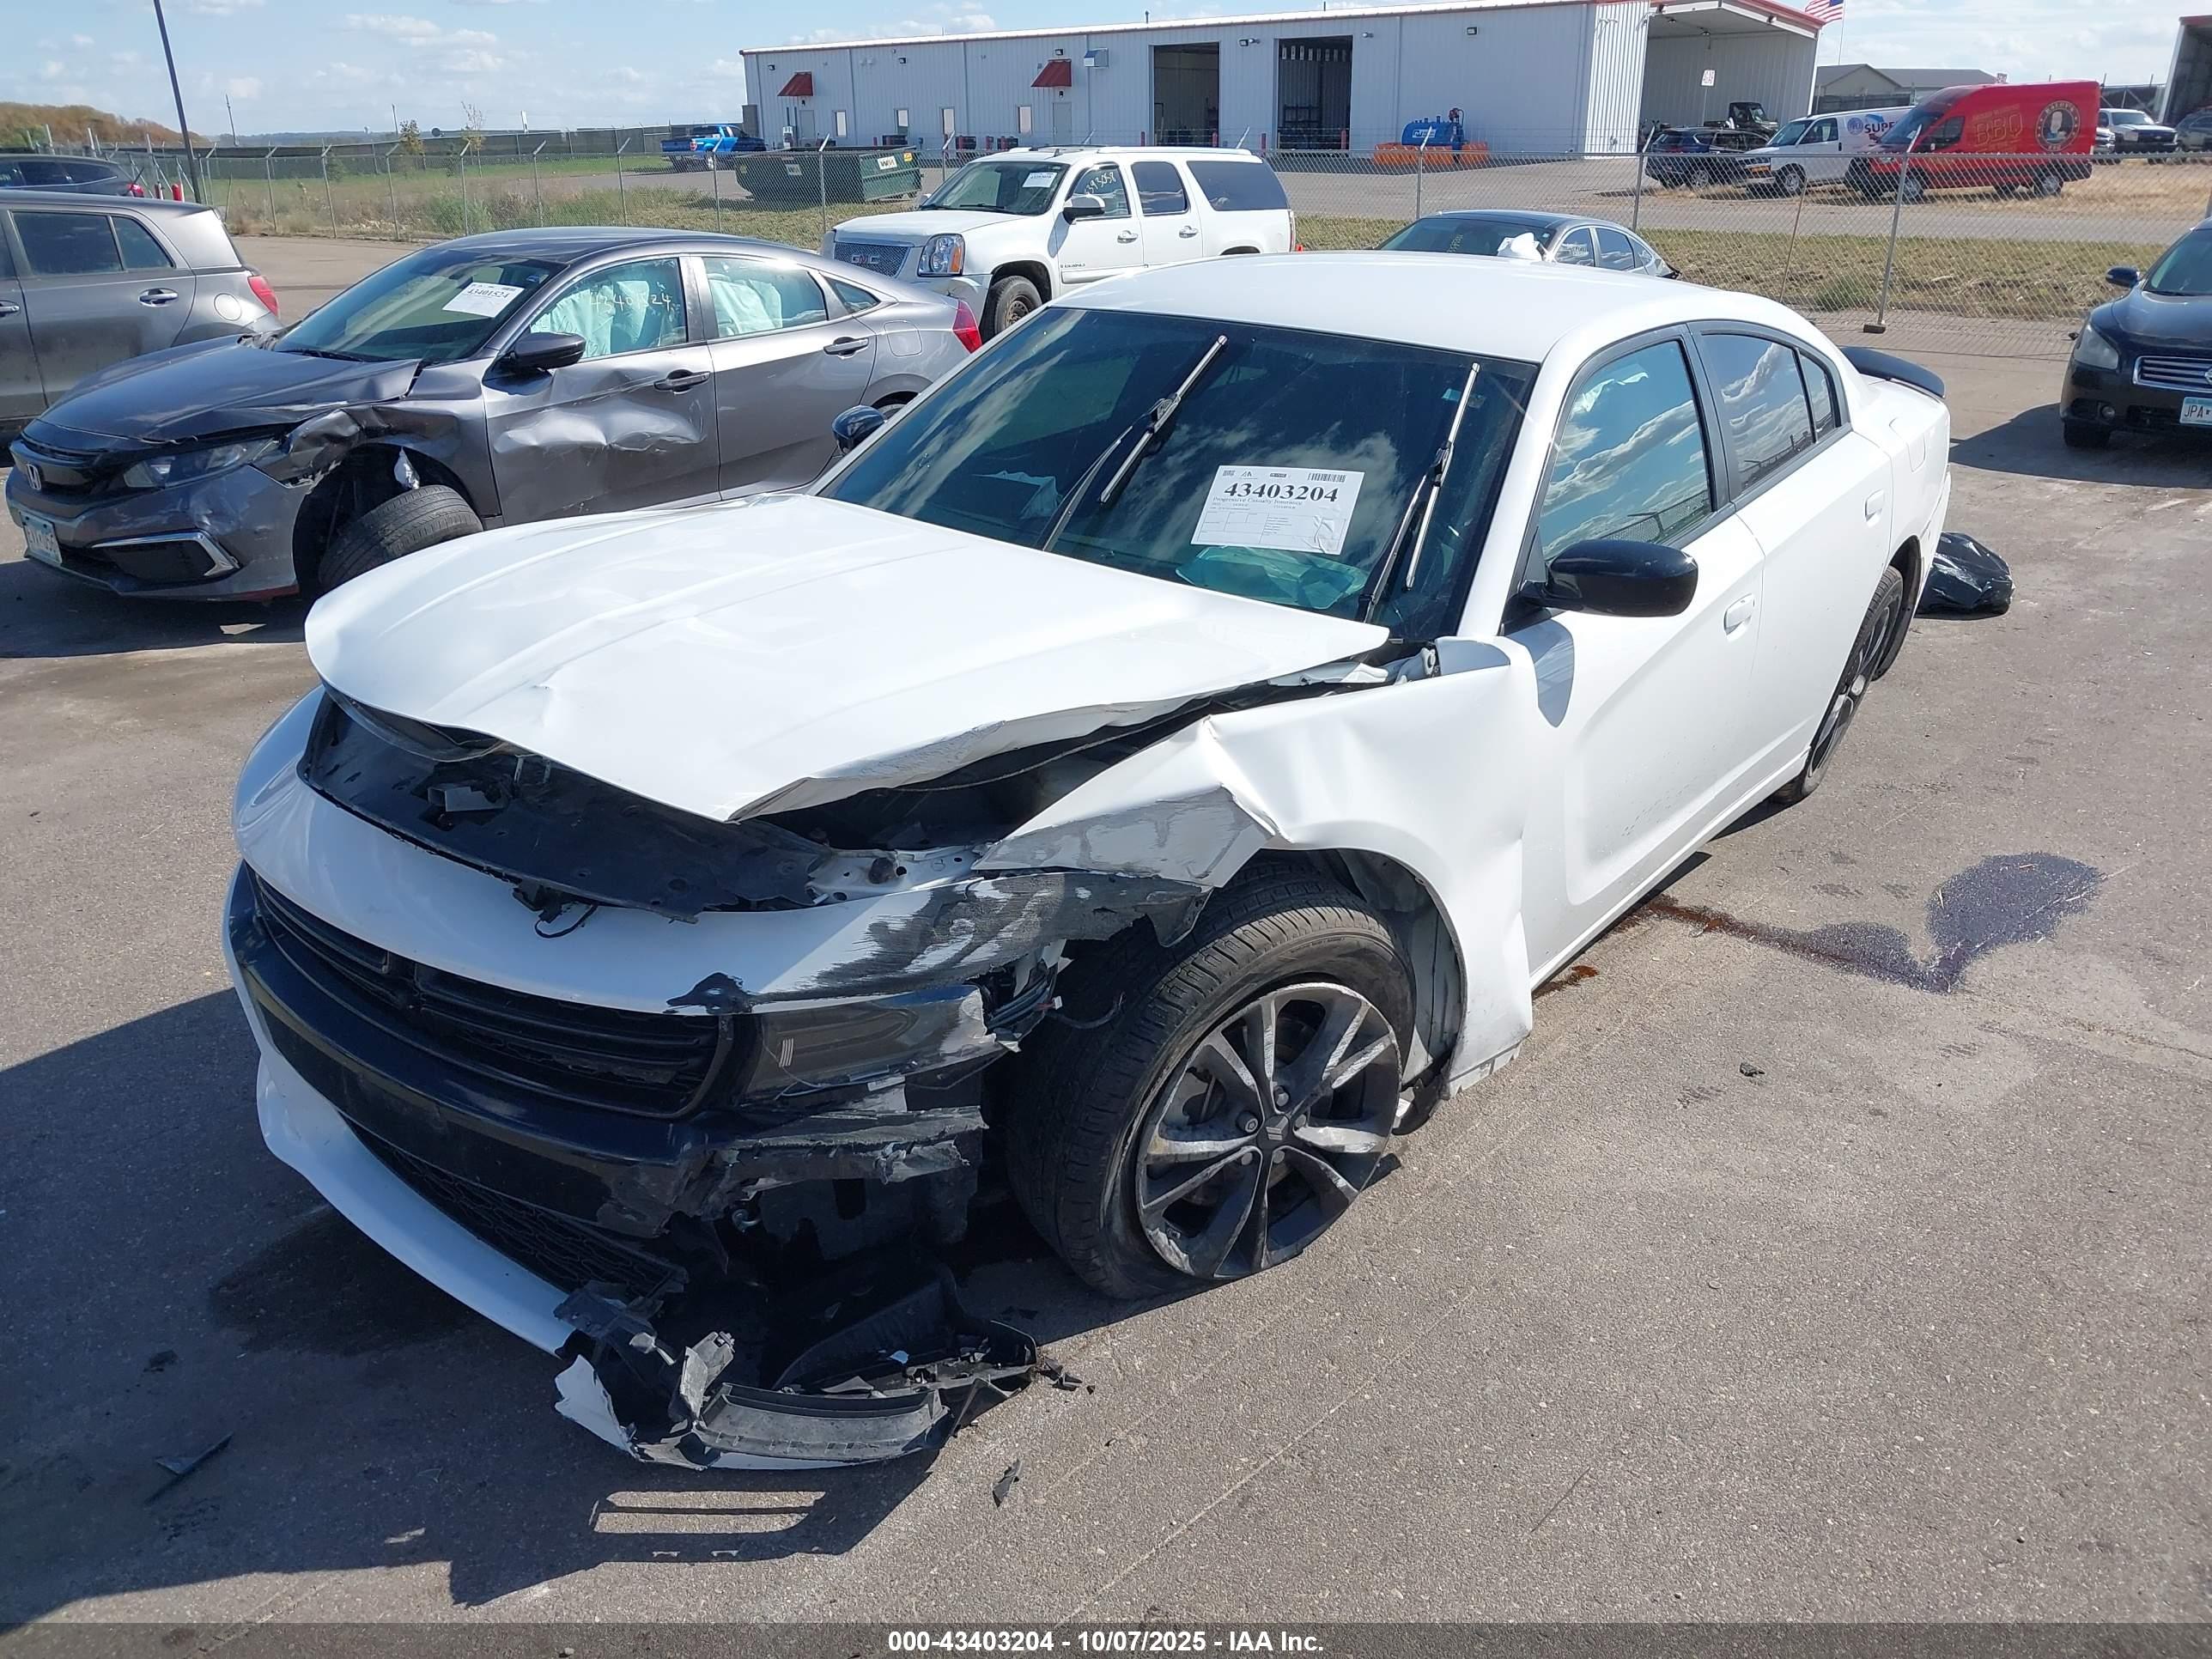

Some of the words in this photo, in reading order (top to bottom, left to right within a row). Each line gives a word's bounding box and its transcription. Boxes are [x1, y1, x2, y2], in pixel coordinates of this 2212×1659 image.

[1974, 112, 2023, 147] BBQ
[851, 254, 879, 264] GMC
[1224, 482, 1340, 502] 43403204
